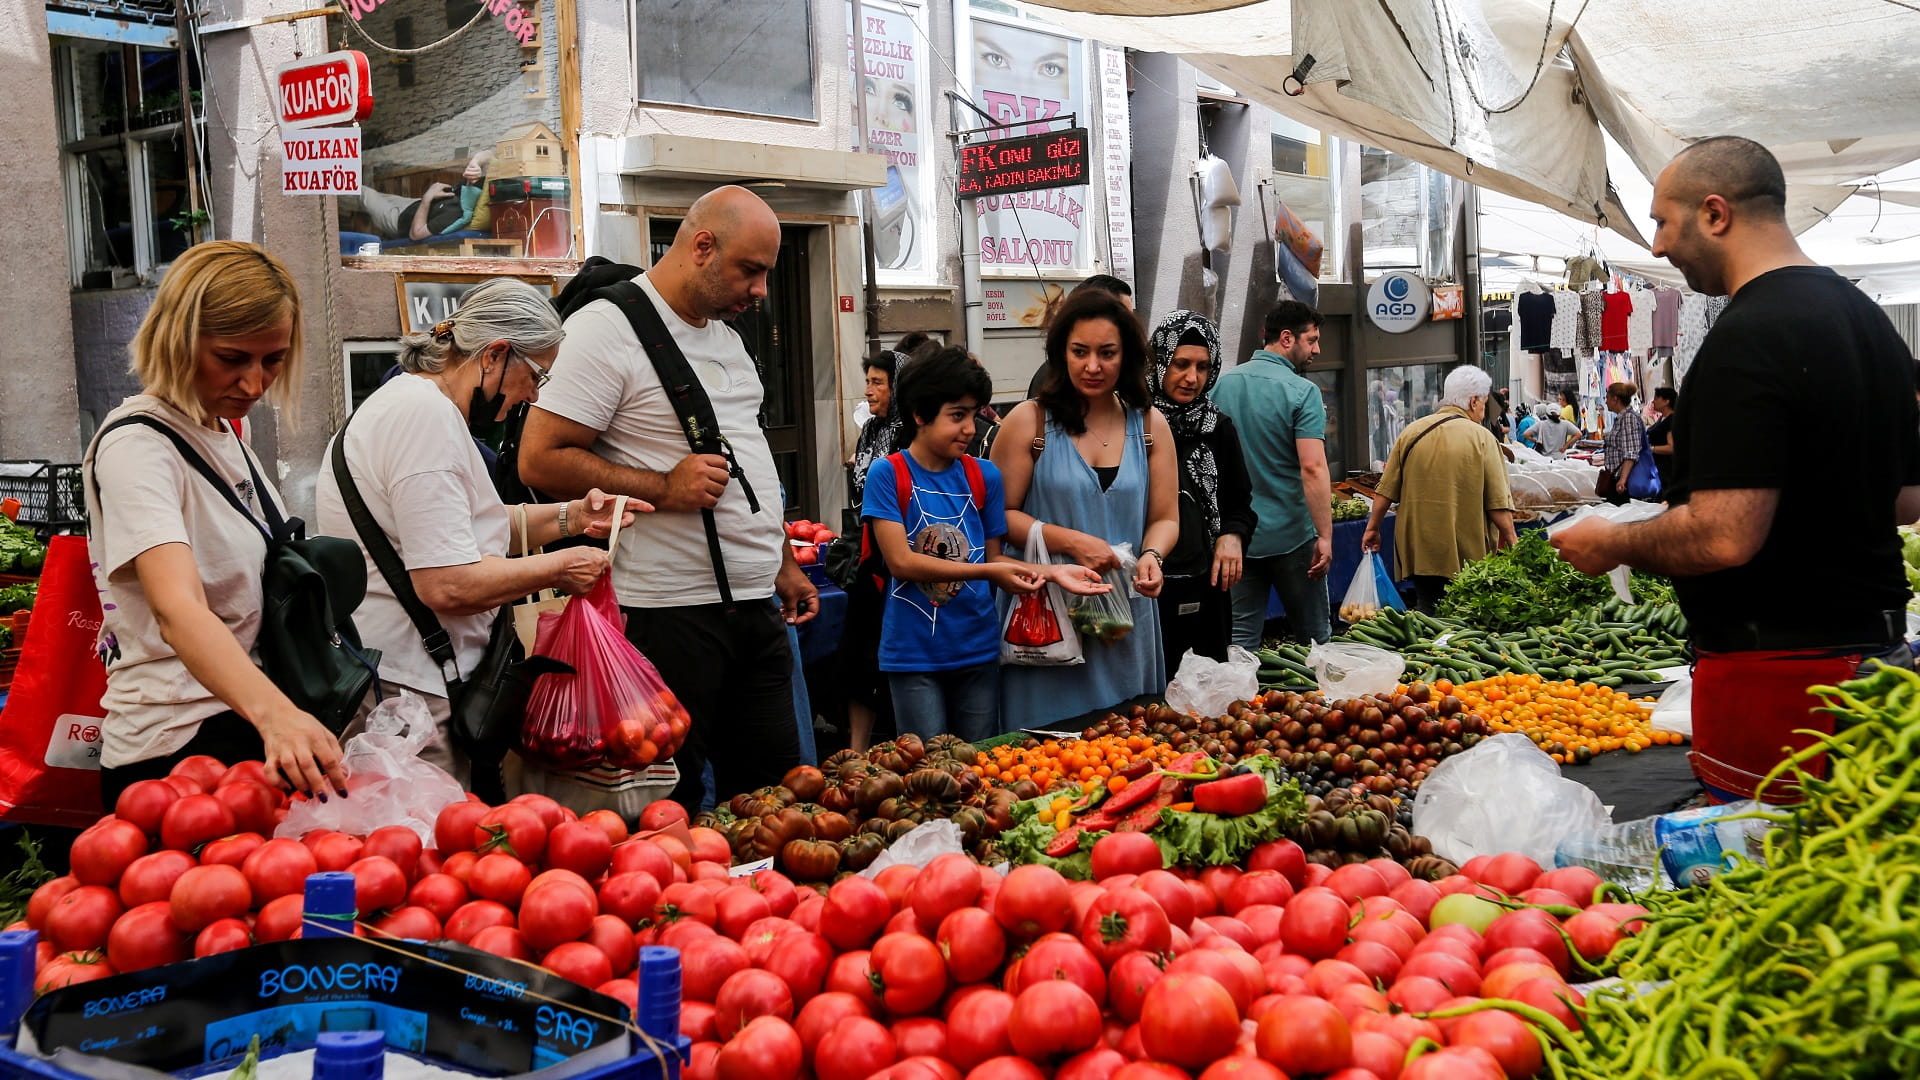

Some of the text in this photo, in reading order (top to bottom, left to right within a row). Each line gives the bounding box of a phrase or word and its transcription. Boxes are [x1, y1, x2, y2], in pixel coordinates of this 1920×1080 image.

[866, 16, 887, 35] FK
[1106, 54, 1119, 68] FK
[279, 67, 353, 117] KUAFÖR
[983, 90, 1061, 141] FK
[283, 138, 359, 161] VOLKAN
[865, 129, 903, 147] AZER
[961, 144, 998, 174] FK
[284, 164, 359, 191] KUAFÖR
[981, 236, 1073, 265] SALONU
[845, 299, 850, 309] 2
[987, 302, 1004, 310] BOYA
[1375, 303, 1416, 315] AGD
[259, 962, 401, 998] BONERA
[465, 973, 526, 999] BONERA
[83, 984, 167, 1019] BONERA
